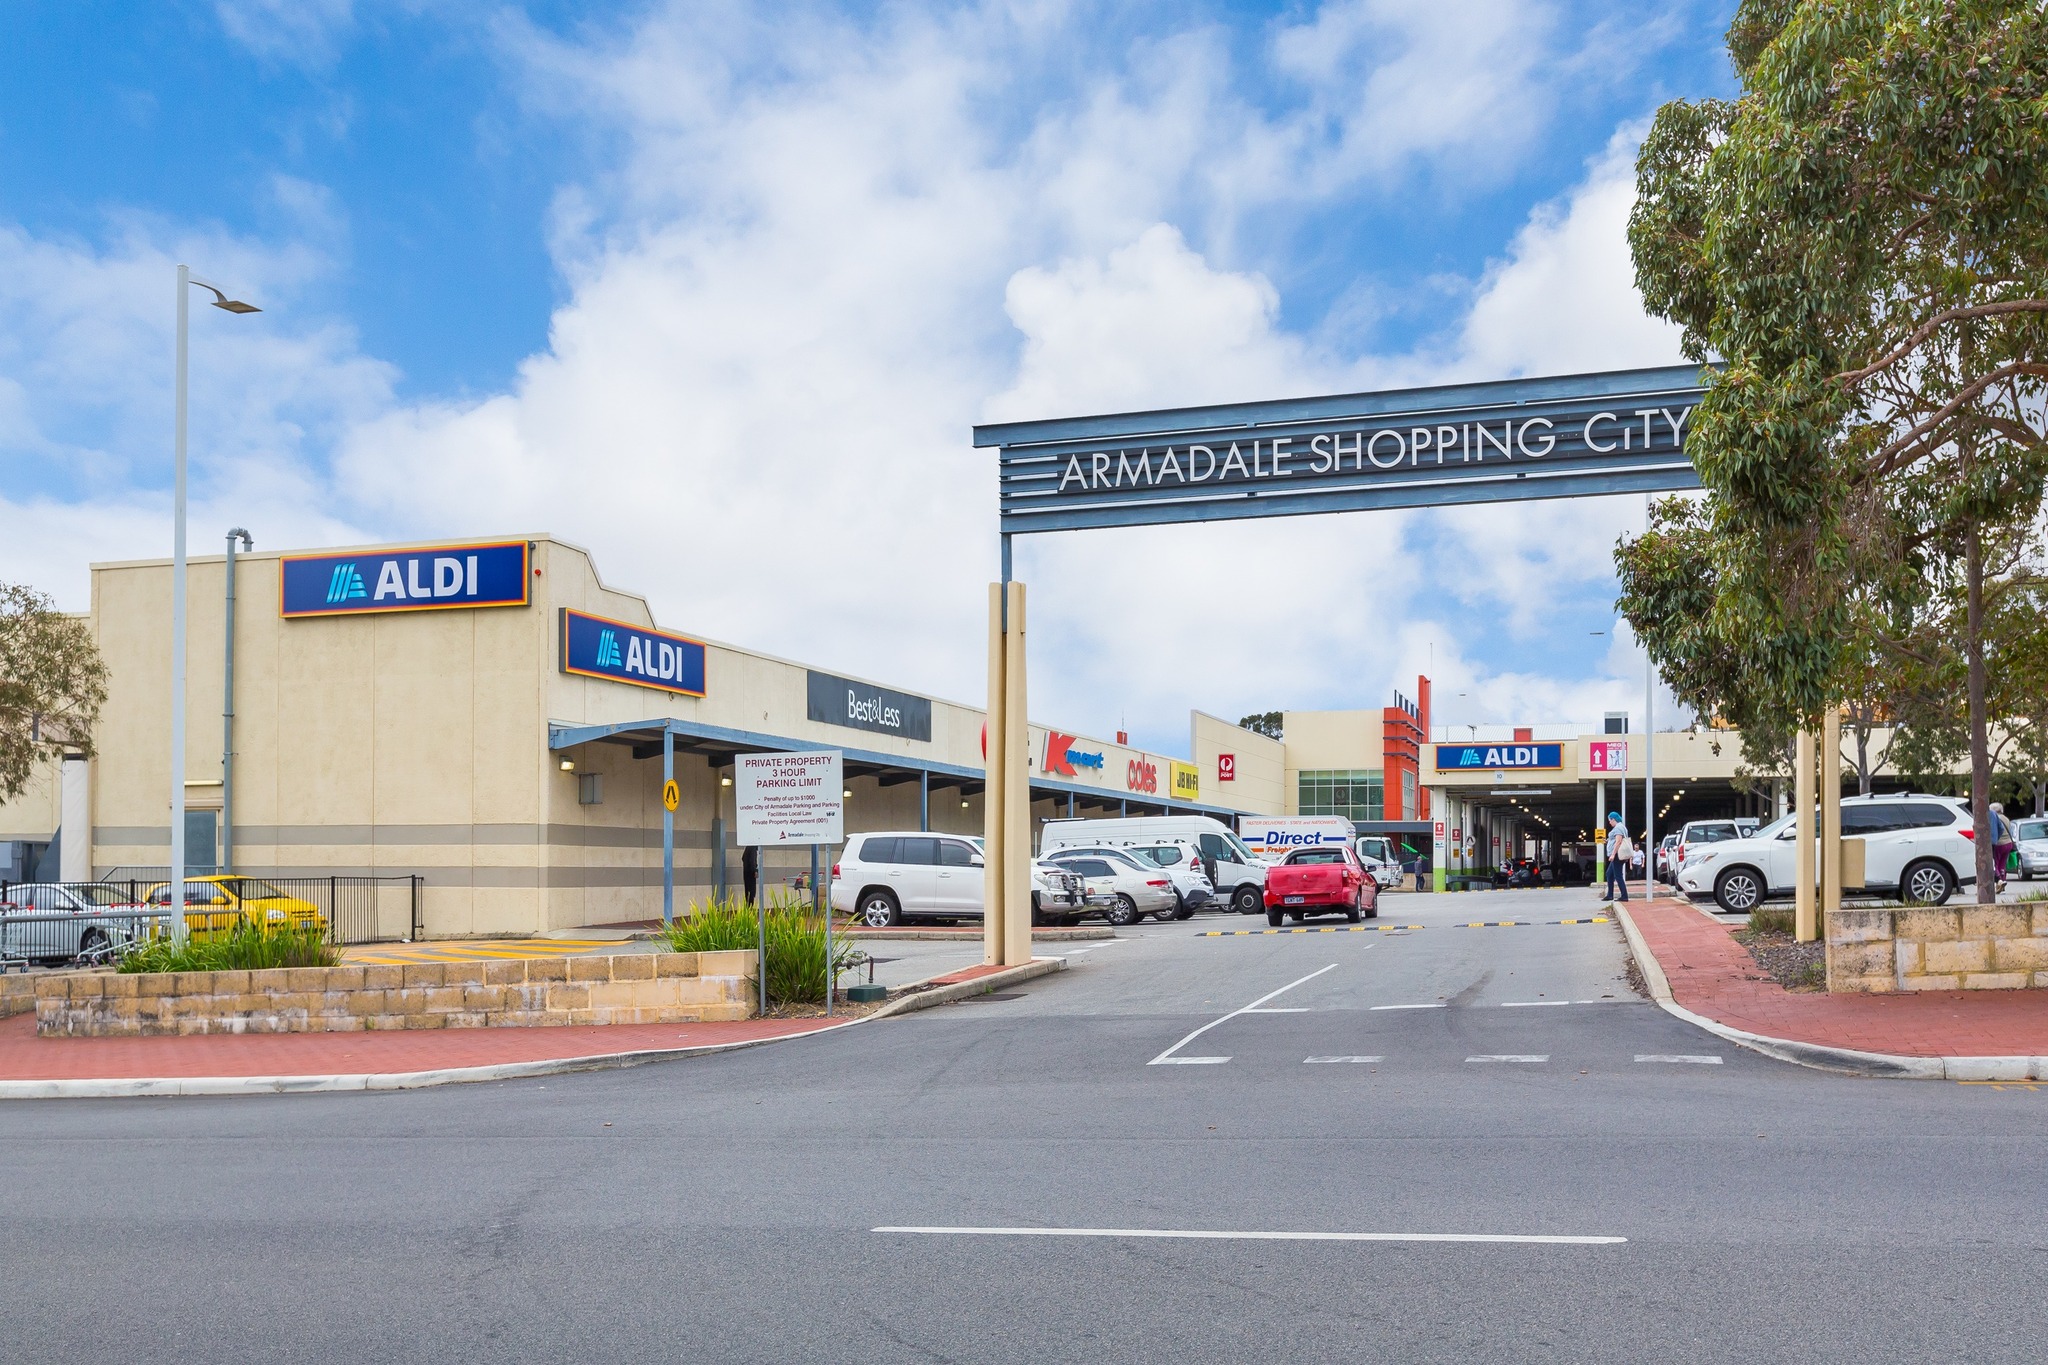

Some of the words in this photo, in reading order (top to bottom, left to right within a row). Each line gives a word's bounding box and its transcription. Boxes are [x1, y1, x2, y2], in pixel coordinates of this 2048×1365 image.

[1058, 437, 1293, 491] ARMADALE
[1309, 416, 1556, 474] SHOPPING
[373, 555, 479, 601] ALDI
[624, 635, 683, 683] ALDI
[848, 689, 900, 728] Best&Less
[745, 758, 782, 768] PRIVATE
[784, 756, 832, 766] PROPERTY
[1484, 747, 1538, 765] ALDI
[772, 768, 778, 777] 3
[780, 768, 806, 777] HOUR
[1127, 753, 1157, 793] coles
[756, 779, 796, 788] PARKING
[799, 777, 822, 787] LIMIT
[769, 818, 789, 826] Property
[1266, 831, 1321, 845] Direct
